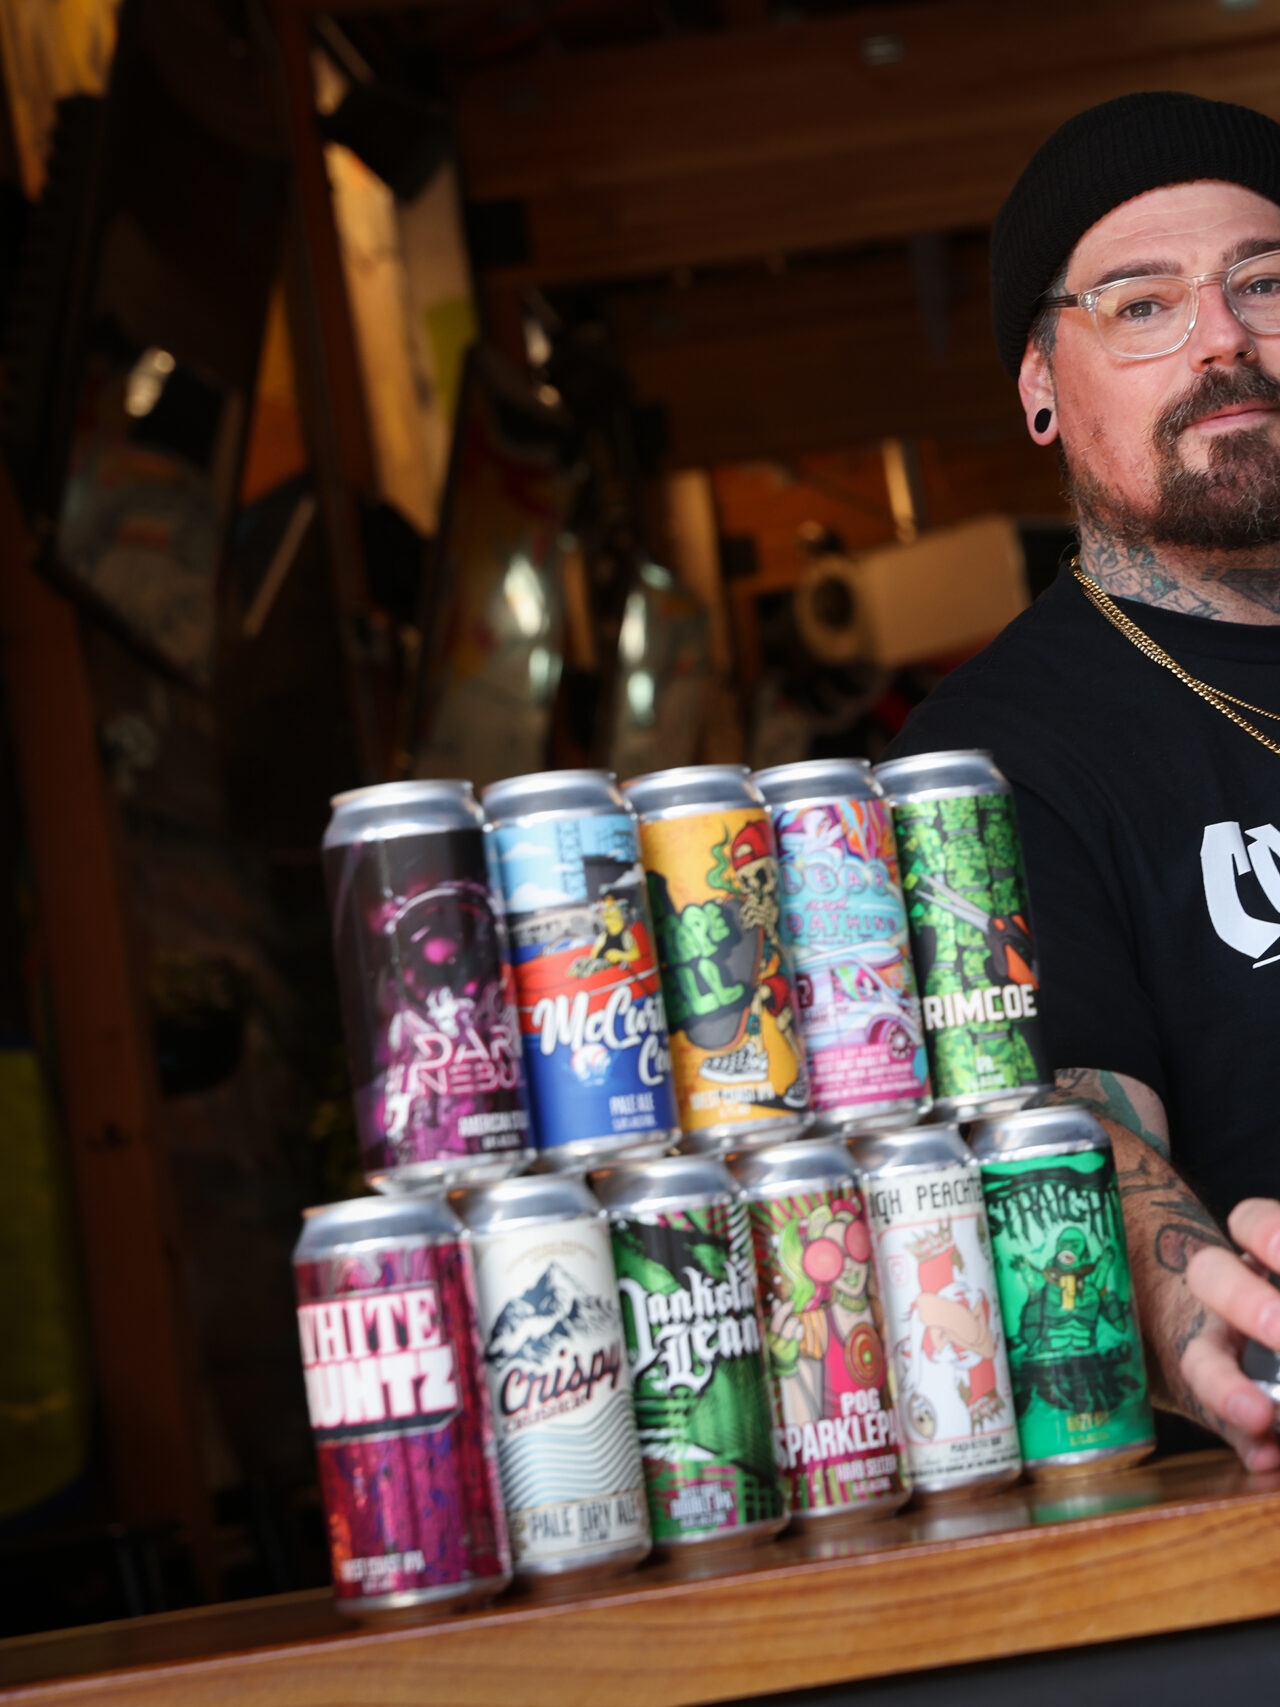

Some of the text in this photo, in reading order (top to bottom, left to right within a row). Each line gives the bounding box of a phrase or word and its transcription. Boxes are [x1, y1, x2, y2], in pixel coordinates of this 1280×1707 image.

[500, 1340, 622, 1418] Crispy
[840, 1386, 881, 1415] POG
[528, 1509, 574, 1541] PALE
[578, 1500, 612, 1534] DRY
